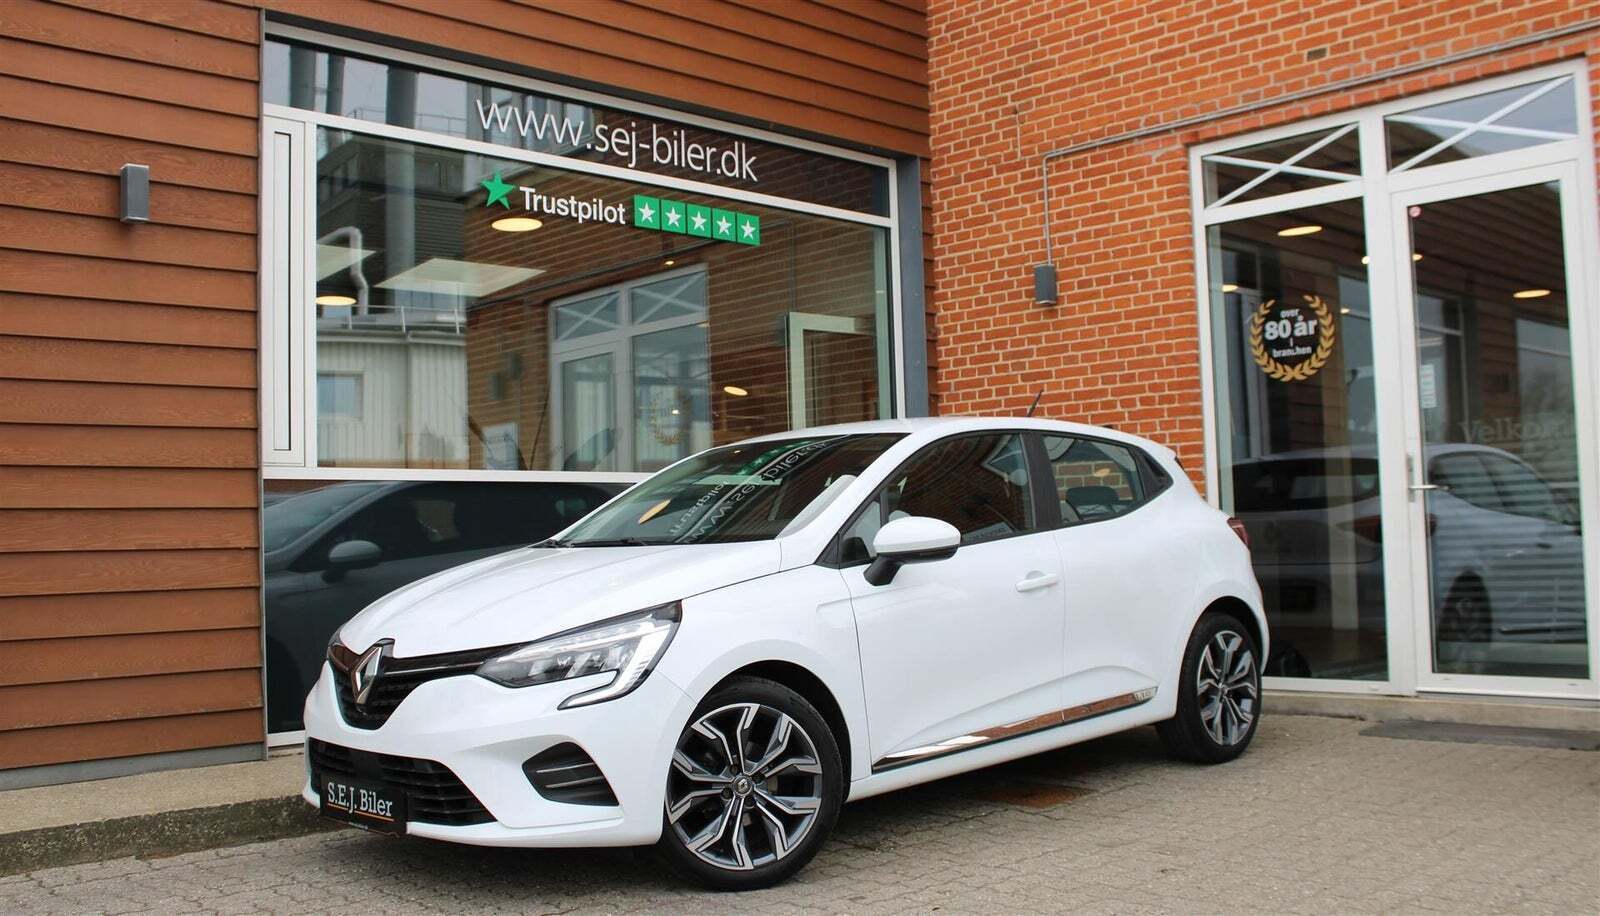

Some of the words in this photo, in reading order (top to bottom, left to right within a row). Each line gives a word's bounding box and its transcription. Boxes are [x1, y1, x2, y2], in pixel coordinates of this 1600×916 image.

[476, 98, 758, 182] www.sej-biler.dk
[519, 186, 626, 225] Trustpilot
[1264, 319, 1292, 340] 80
[1294, 315, 1318, 336] år
[1280, 309, 1300, 318] over
[327, 782, 358, 814] S.E.J.
[360, 788, 393, 817] Biler
